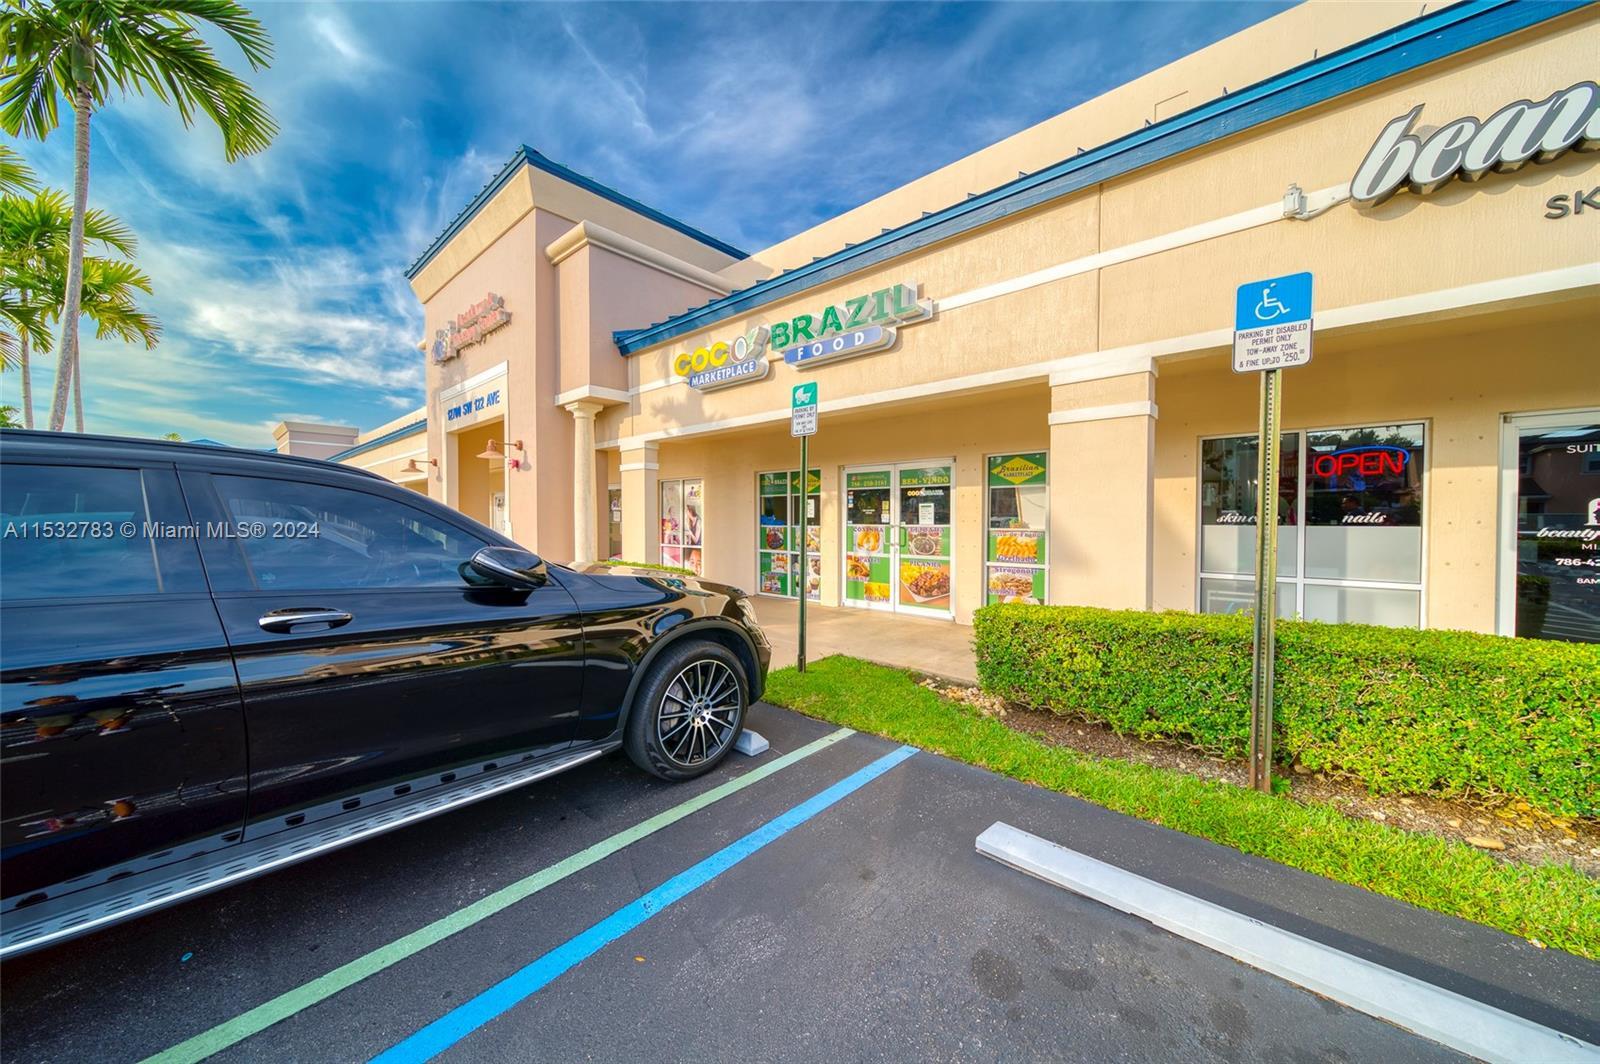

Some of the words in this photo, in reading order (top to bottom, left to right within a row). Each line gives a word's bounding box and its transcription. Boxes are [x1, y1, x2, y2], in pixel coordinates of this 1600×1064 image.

[770, 284, 921, 351] BRAZIL
[1239, 329, 1264, 340] PARKING
[1265, 327, 1274, 336] BY
[1276, 323, 1308, 335] DISABLED
[1251, 336, 1274, 346] PERMIT
[1276, 334, 1292, 343] ONLY
[797, 331, 865, 361] FOOD
[1246, 345, 1278, 356] TOW-AWAY
[1280, 342, 1298, 352] ZONE
[1246, 358, 1260, 367] FINE
[691, 361, 755, 387] MARKETPLACE
[462, 400, 473, 416] SW
[474, 396, 485, 411] 122
[486, 389, 500, 407] AVE
[1314, 452, 1404, 477] OPEN
[1216, 512, 1247, 523] skin
[1342, 511, 1387, 524] nails
